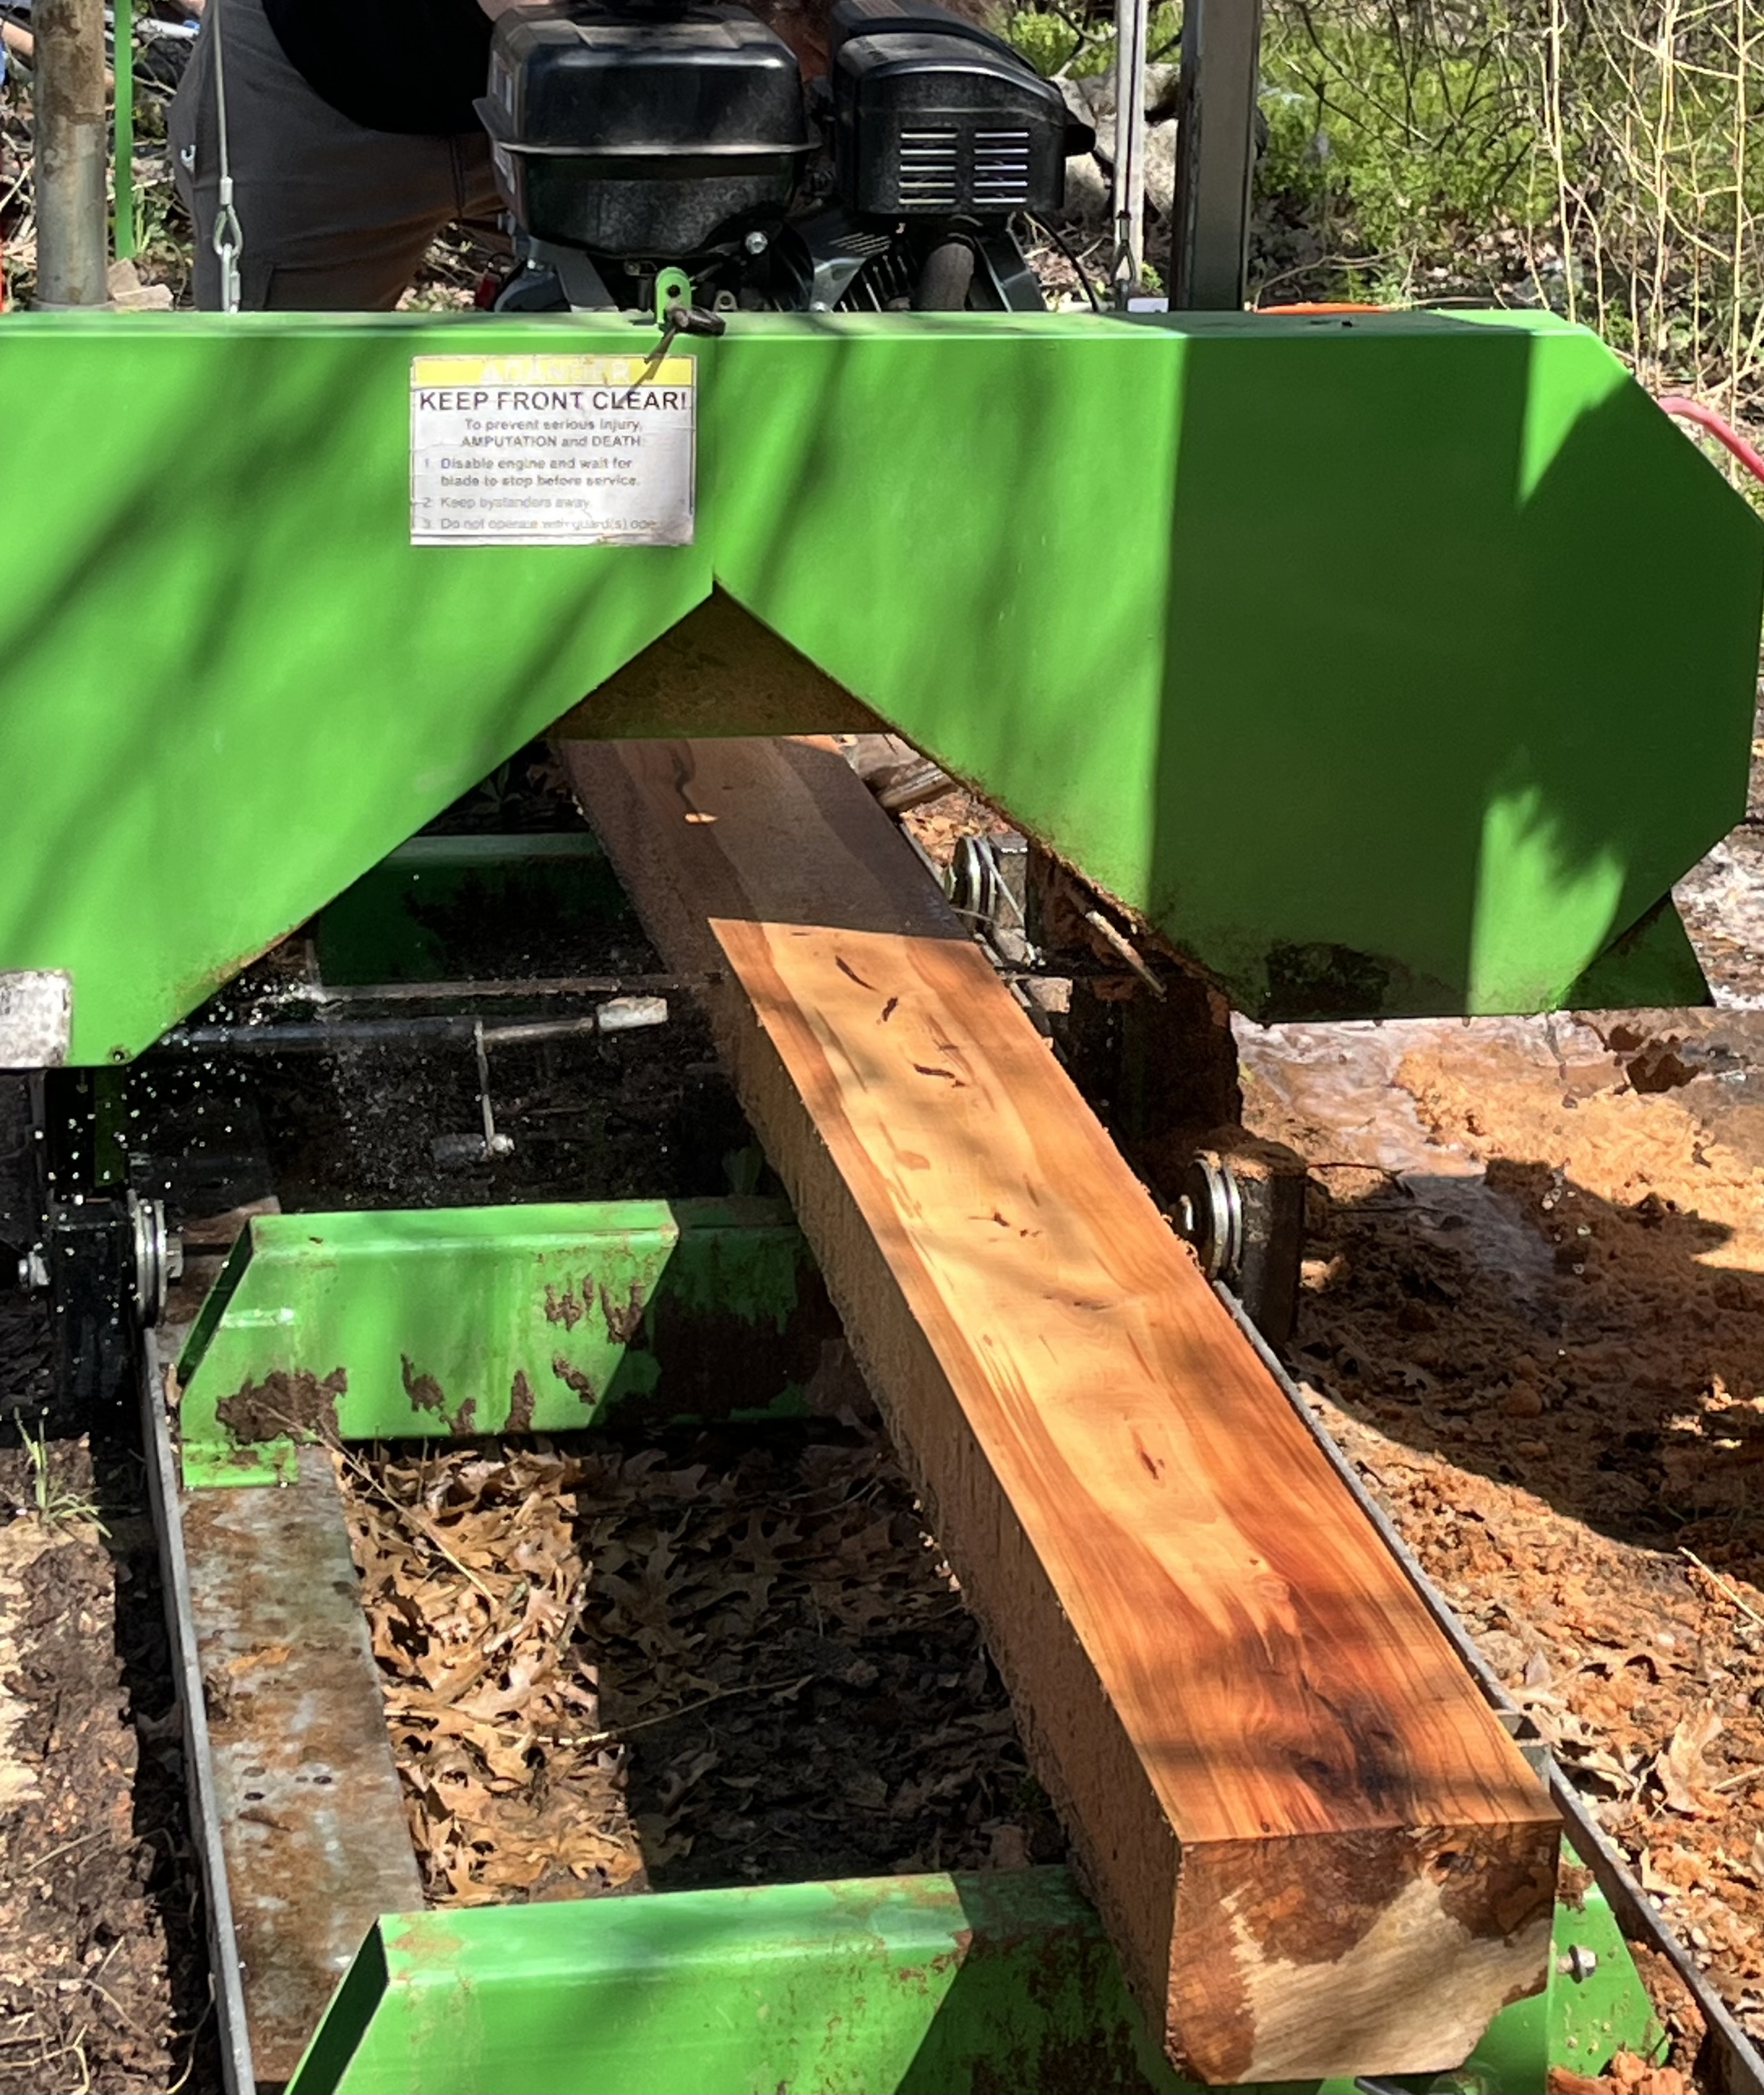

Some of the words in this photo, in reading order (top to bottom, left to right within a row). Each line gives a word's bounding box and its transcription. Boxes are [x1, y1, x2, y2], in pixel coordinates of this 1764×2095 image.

[420, 391, 489, 410] KEEP
[497, 391, 584, 411] FRONT
[593, 391, 687, 410] CLEAR!
[466, 419, 481, 430] To
[486, 419, 539, 433] prevent
[543, 419, 595, 431] serious
[462, 435, 557, 448] AMPUTATION
[561, 436, 587, 447] and
[441, 457, 494, 469] Disable
[498, 458, 546, 471] engine
[550, 458, 575, 469] and
[580, 457, 608, 468] wait
[612, 456, 633, 468] for
[441, 475, 479, 487] blade
[485, 476, 498, 487] to
[502, 476, 532, 488] stop
[537, 475, 582, 486] before
[586, 474, 640, 486] service.
[441, 497, 476, 509] Keep
[479, 497, 552, 511] bystanders
[441, 518, 460, 529] Do
[464, 519, 485, 529] not
